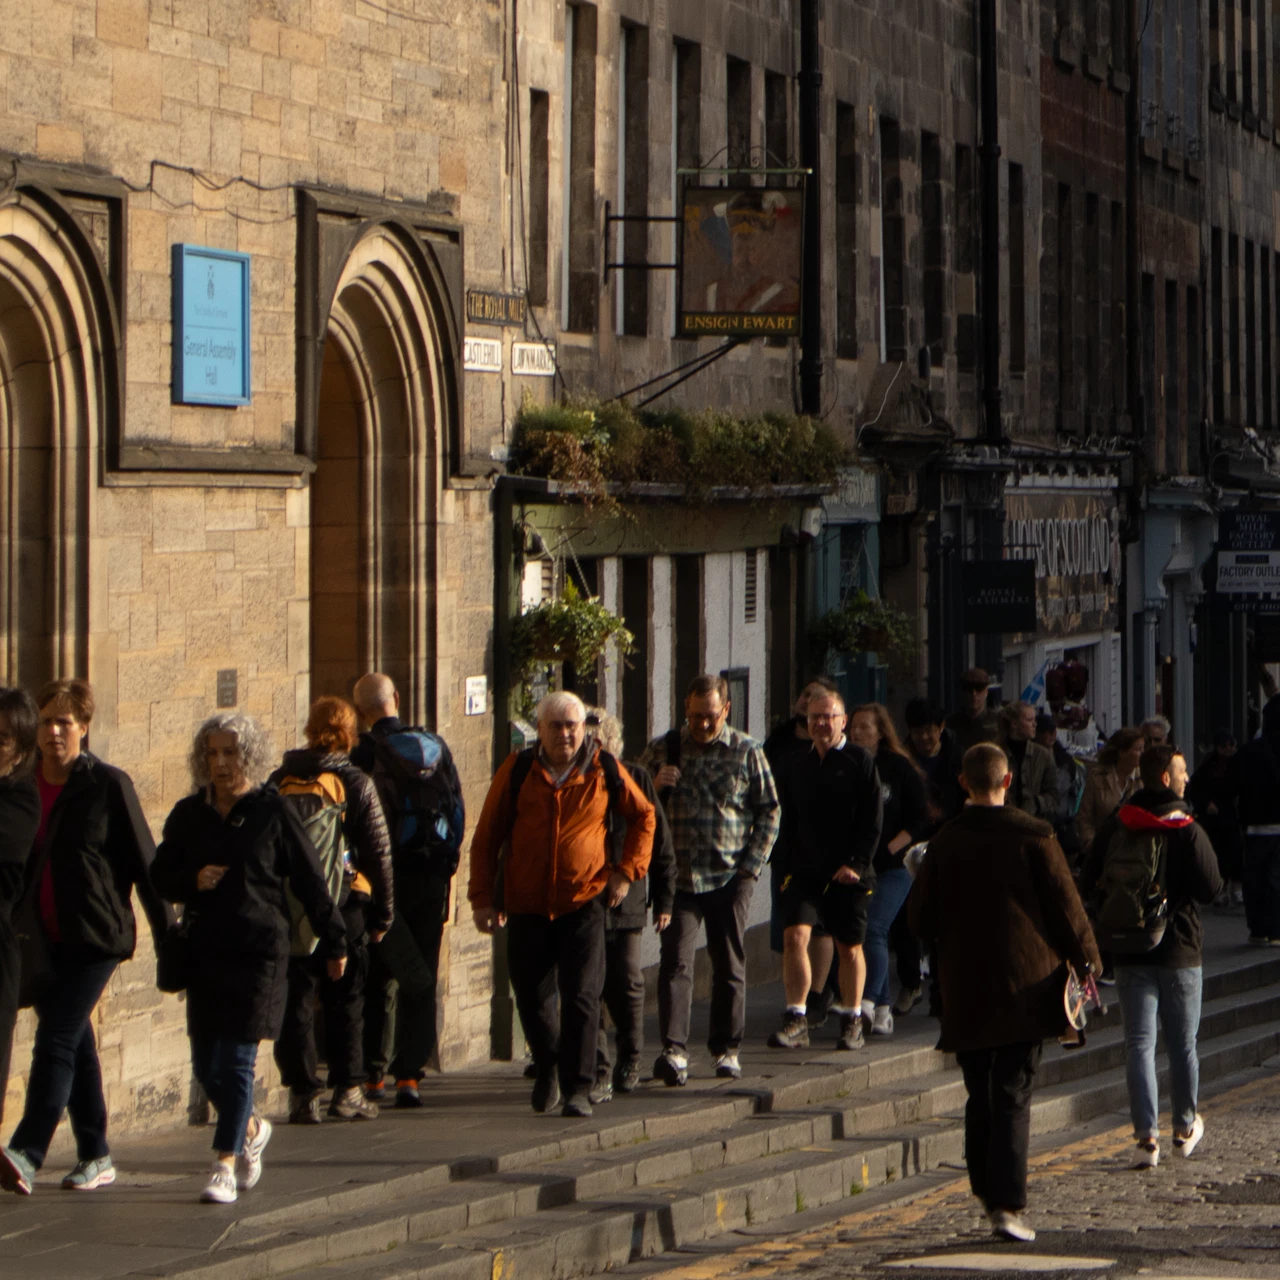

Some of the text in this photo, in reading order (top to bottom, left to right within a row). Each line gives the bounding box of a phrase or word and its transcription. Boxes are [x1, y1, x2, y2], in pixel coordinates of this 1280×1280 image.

[471, 293, 524, 322] THE ROYAL MILE
[685, 316, 796, 329] ENSIGN EWART
[1236, 514, 1271, 523] ROYAL
[1240, 522, 1267, 531] MILE
[1229, 531, 1276, 541] FACTORY
[1061, 517, 1110, 576] SCOTLAND
[1232, 540, 1273, 549] OUTLET
[1219, 566, 1253, 578] FACTORY
[980, 588, 1016, 597] ROYAL
[1234, 603, 1257, 611] GIFT
